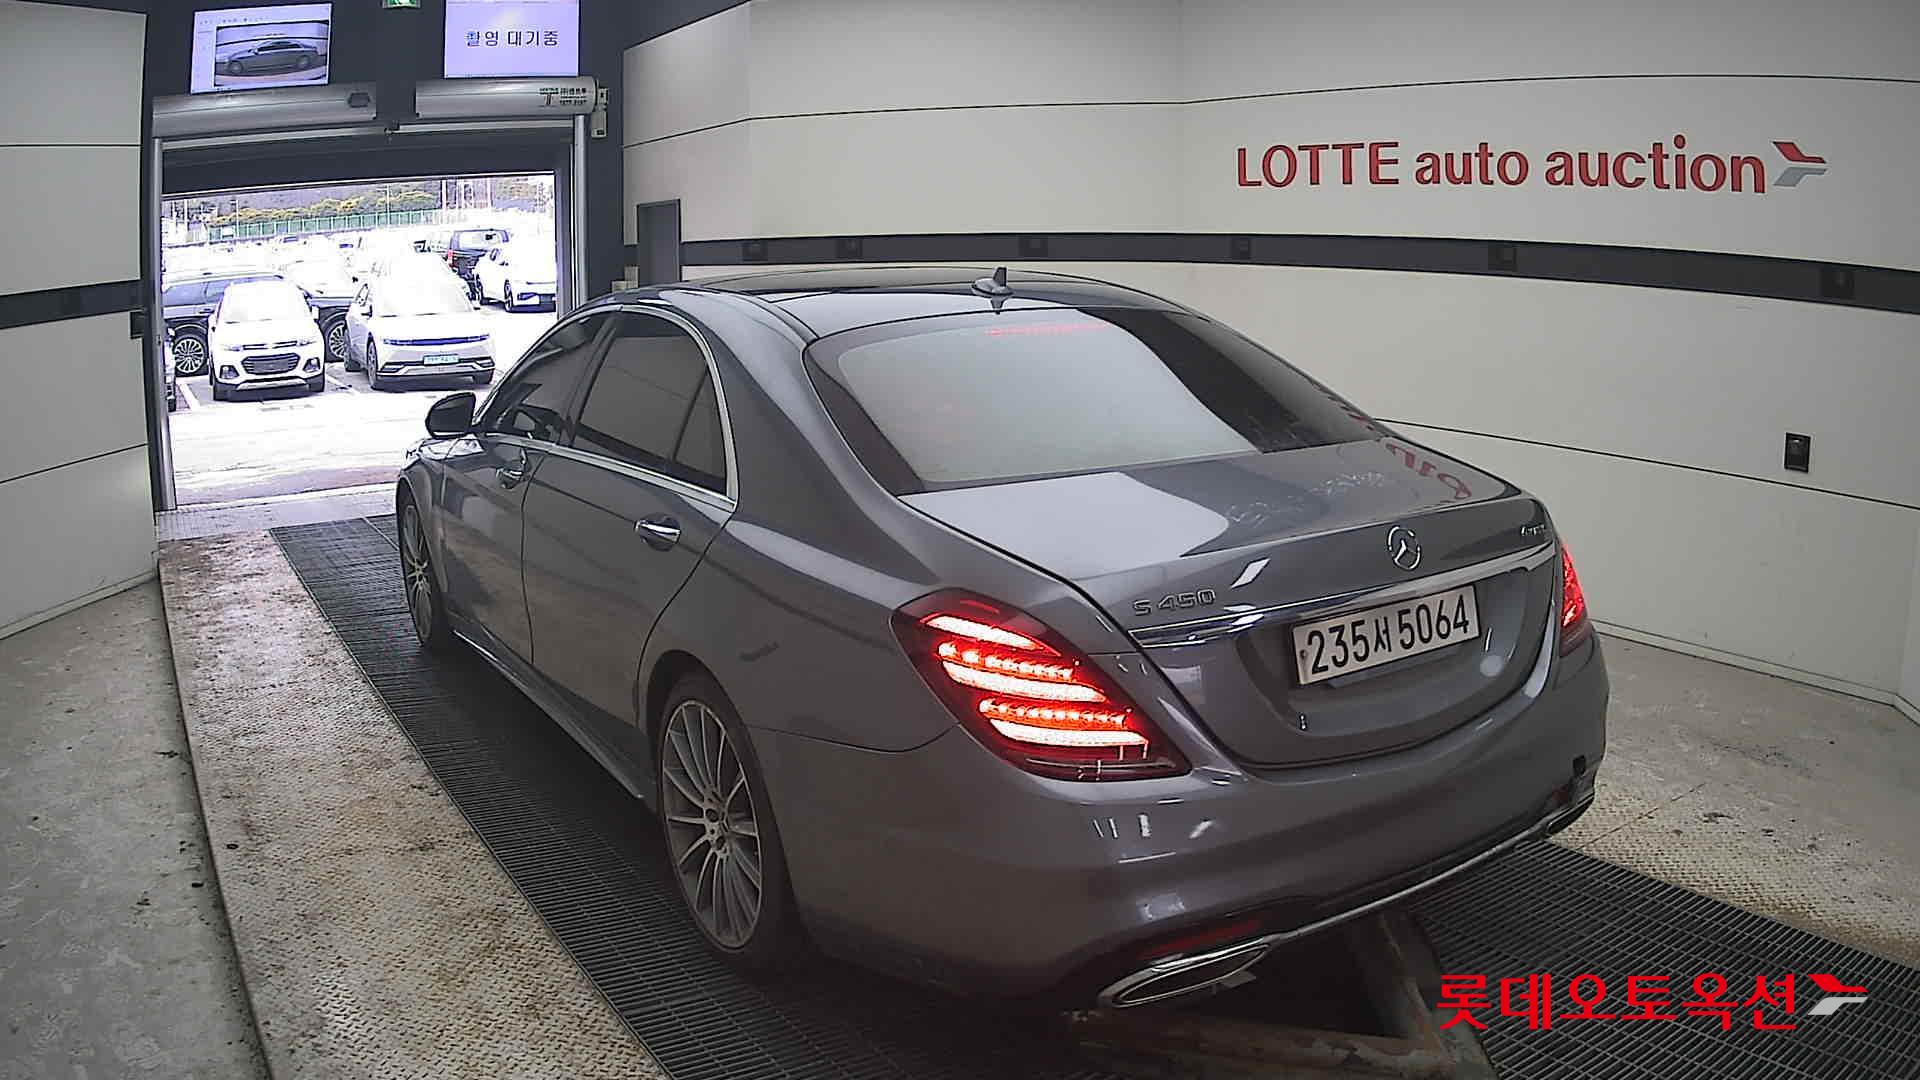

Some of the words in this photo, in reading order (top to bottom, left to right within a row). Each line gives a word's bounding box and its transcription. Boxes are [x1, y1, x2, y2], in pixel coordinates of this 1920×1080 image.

[507, 31, 558, 46] 대기중
[1237, 141, 1400, 188] LOTTE
[1415, 142, 1529, 187] auto
[1544, 134, 1766, 194] auction
[1133, 599, 1152, 616] S
[1157, 588, 1216, 611] 450
